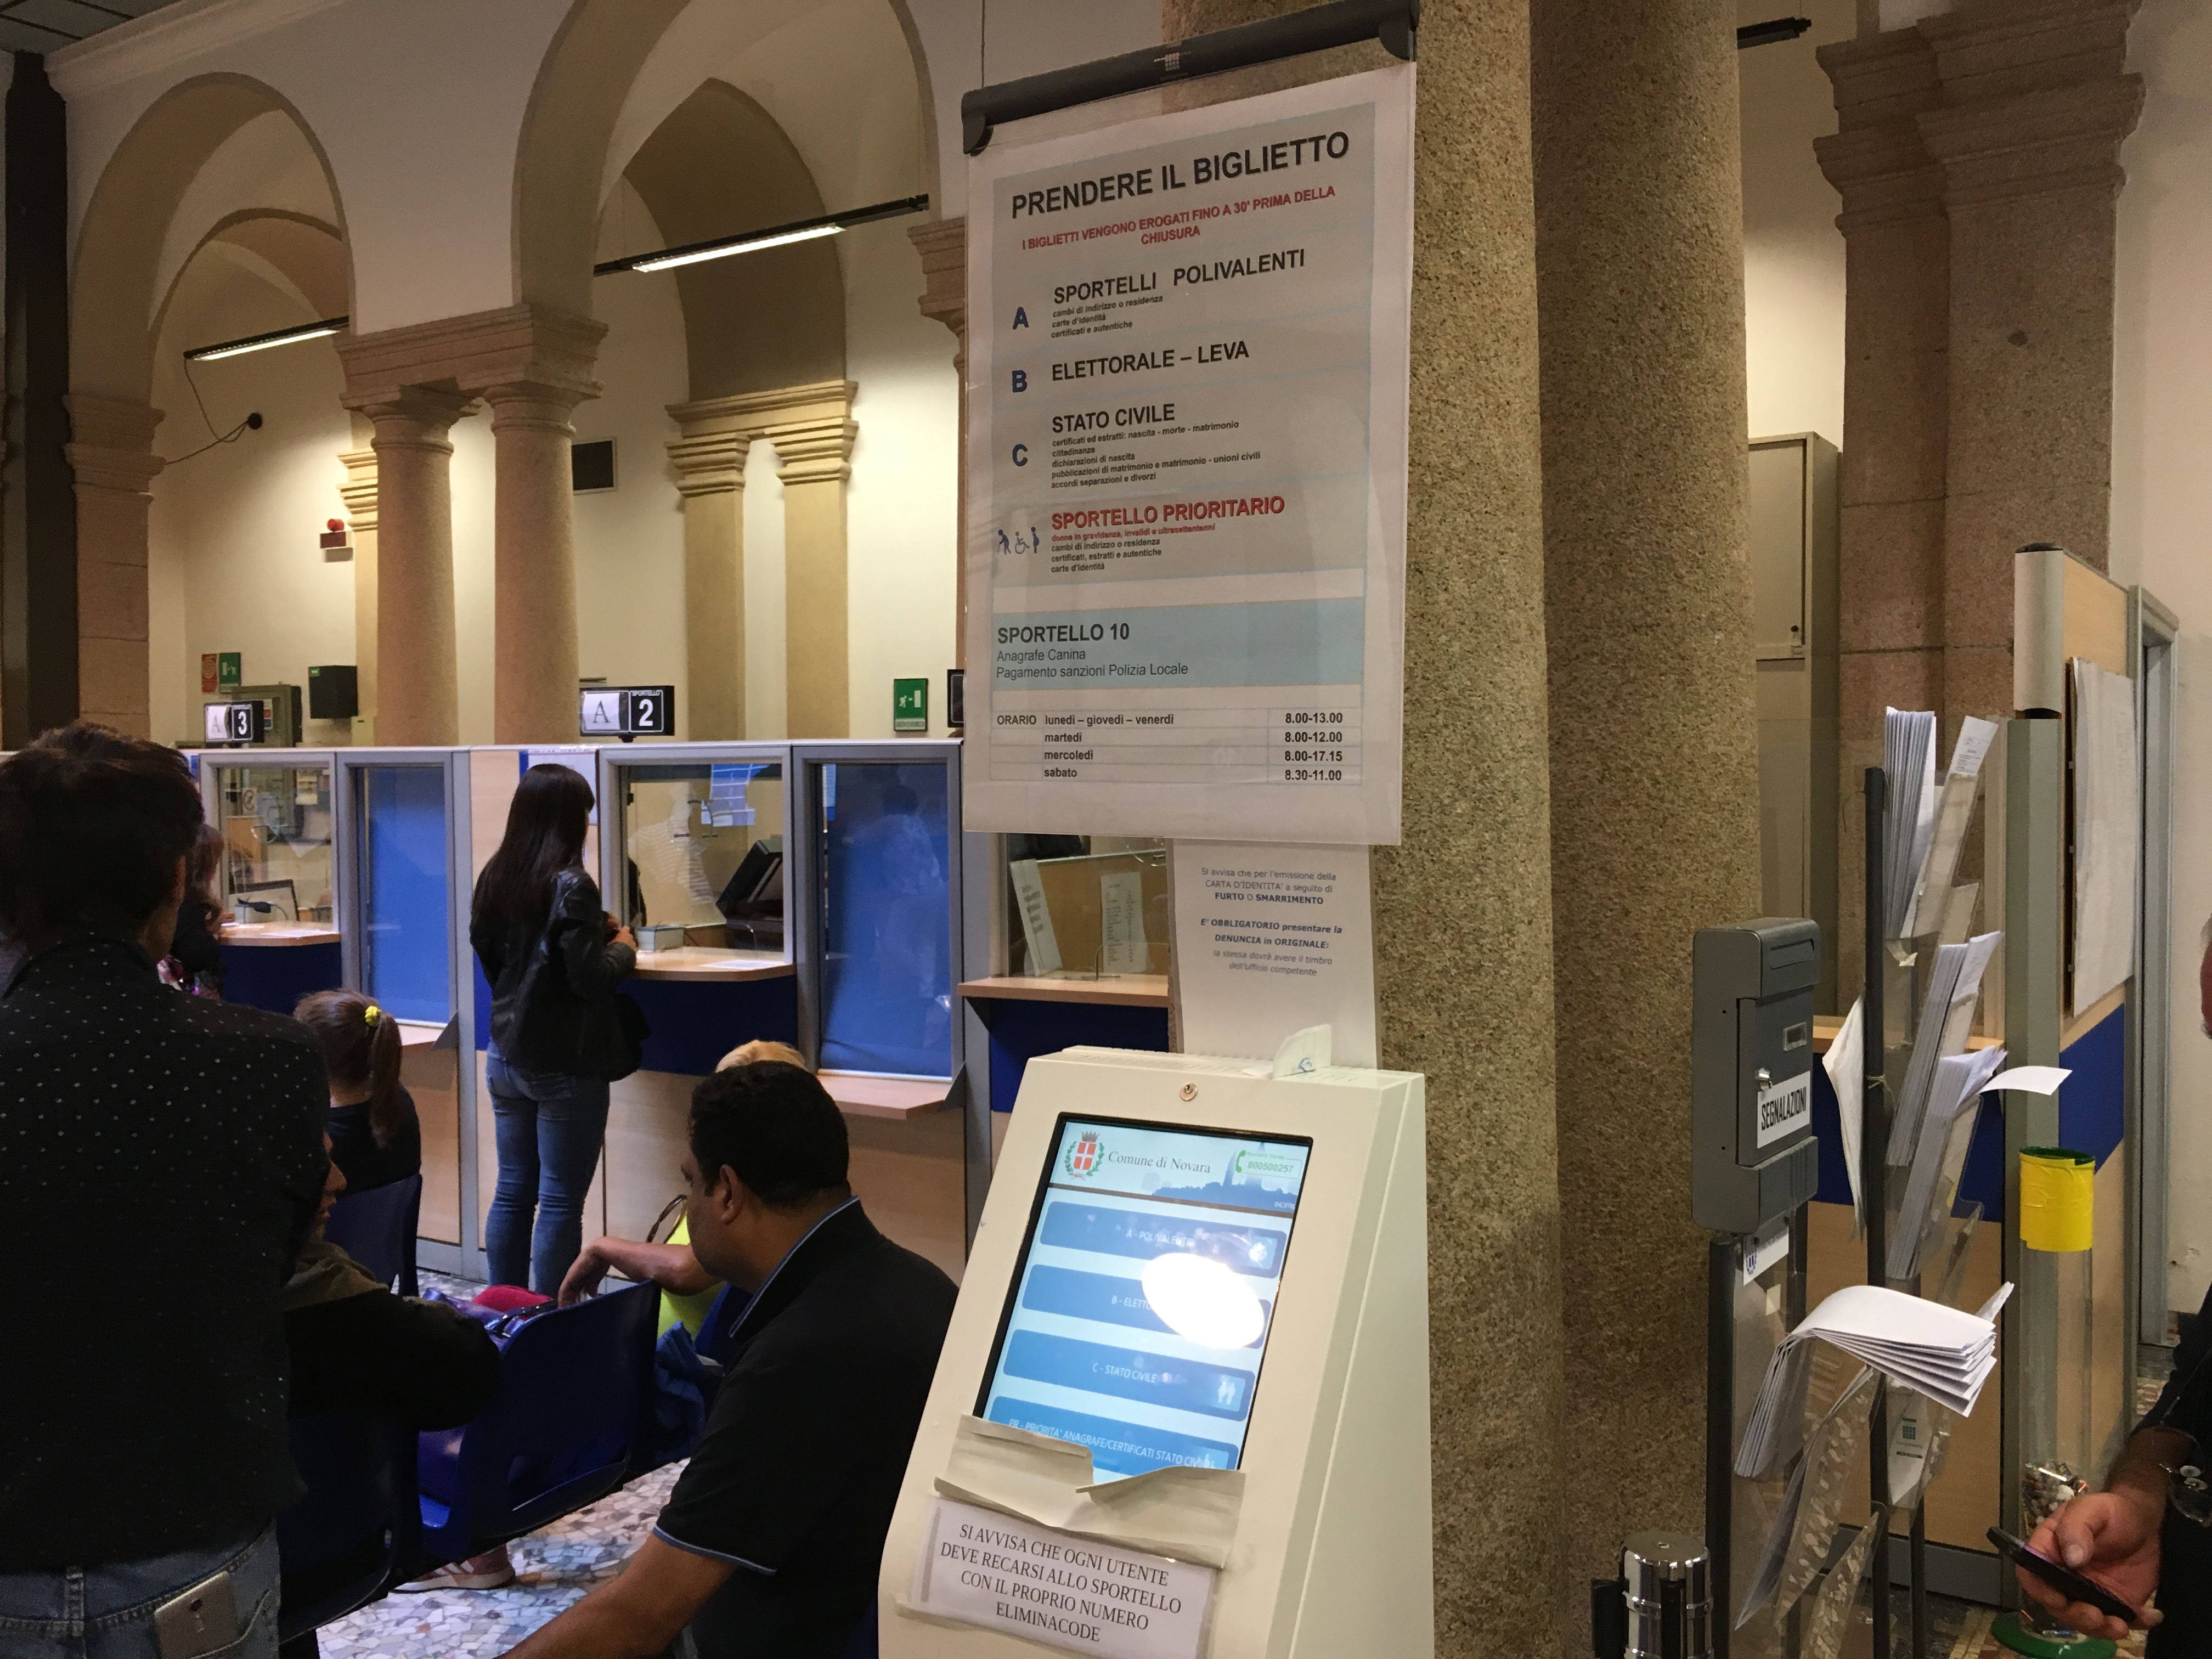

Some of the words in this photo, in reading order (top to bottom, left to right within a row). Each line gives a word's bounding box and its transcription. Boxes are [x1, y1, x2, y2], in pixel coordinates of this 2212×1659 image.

[1012, 169, 1153, 218] PRENDERE
[1162, 165, 1185, 190] IL
[1193, 131, 1349, 185] BIGLIETTO
[1028, 230, 1079, 249] BIGLIETTI
[1081, 222, 1136, 240] VENGONO
[1139, 212, 1189, 231] EROGATI
[1192, 207, 1220, 221] FINO
[1222, 205, 1232, 216] A
[1253, 193, 1291, 211] PRIMA
[1294, 186, 1335, 203] DELLA
[1141, 226, 1200, 246] CHIUSURA
[1054, 272, 1156, 304] SPORTELLI
[1173, 249, 1305, 286] POLIVALENTI
[1053, 308, 1074, 318] cambi
[1086, 302, 1116, 313] indirizzo
[1126, 296, 1163, 307] residenza
[1012, 307, 1029, 330] A
[1052, 318, 1070, 328] carte
[1051, 326, 1085, 338] certificati
[1093, 321, 1132, 332] autentiche
[1052, 349, 1175, 381] ELETTORALE
[1198, 341, 1249, 364] LEVA
[1012, 370, 1027, 391] B
[1052, 411, 1109, 433] STATO
[1115, 403, 1175, 427] CIVILE
[1052, 436, 1085, 447] certificati
[1128, 430, 1155, 438] nascita
[1163, 426, 1186, 435] morte
[1193, 421, 1239, 432] matrimonio
[1012, 444, 1028, 467] C
[1052, 446, 1095, 456] cittadinanze
[1052, 457, 1097, 467] dichiarazioni
[1109, 453, 1135, 461] nascita
[1052, 467, 1099, 479] pubblicazioni
[1110, 462, 1153, 472] matrimonio
[1162, 456, 1206, 468] matrimonio
[1214, 454, 1239, 463] unioni
[1242, 452, 1261, 460] civili
[1051, 478, 1078, 488] accordi
[1080, 475, 1122, 487] separazioni
[1131, 472, 1156, 481] divorzi
[1052, 506, 1158, 530] SPORTELLO
[1163, 496, 1284, 521] PRIORITARIO
[1052, 533, 1073, 542] donne
[1083, 529, 1123, 541] gravidanza,
[1125, 528, 1150, 537] invalidi
[1052, 542, 1073, 551] cambi
[1084, 539, 1115, 549] indirizzo
[1124, 538, 1160, 548] residenza
[1052, 552, 1087, 562] certificati,
[1089, 551, 1114, 560] estratti
[1123, 548, 1161, 557] autentiche
[997, 624, 1104, 644] SPORTELLO
[1110, 623, 1130, 641] 10
[997, 649, 1045, 664] Anagrafe
[1048, 648, 1086, 661] Canina
[996, 665, 1057, 680] Pagamento
[1060, 663, 1105, 678] sanzioni
[1109, 663, 1147, 676] Polizia
[1150, 662, 1188, 676] Locale
[592, 700, 610, 723] A
[639, 699, 653, 726] 2
[997, 715, 1036, 725] ORARIO
[1285, 712, 1343, 724] 8.00-13.00
[238, 712, 247, 735] 3
[1285, 731, 1342, 743] 8.00-12.00
[1284, 749, 1342, 762] 8.00-17.15
[1044, 768, 1077, 777] sabato
[1284, 769, 1342, 781] 8.30-11.00
[1269, 870, 1314, 880] l'emissione
[1317, 872, 1336, 881] della
[1205, 880, 1231, 888] CARTA
[1294, 884, 1323, 893] seguito
[1256, 894, 1323, 905] SMARRIMENTO
[1211, 919, 1279, 930] OBBLIGATORIO
[1282, 923, 1331, 933] presentare
[1215, 935, 1261, 944] DENUNCIA
[1274, 938, 1329, 949] ORIGINALE:
[1223, 950, 1246, 959] stessa
[1250, 952, 1272, 960] dovrà
[1274, 954, 1296, 962] avere
[1306, 956, 1332, 964] timbro
[1271, 966, 1317, 975] competente
[1761, 1086, 1806, 1131] SEGNALAZIONI
[1108, 1151, 1153, 1168] Comune
[1156, 1156, 1166, 1168] di
[1170, 1158, 1211, 1173] Novara
[1248, 1161, 1294, 1172] 800500257
[1111, 1295, 1117, 1304] B
[1093, 1363, 1098, 1373] C
[1105, 1365, 1130, 1378] STATO
[1132, 1369, 1156, 1383] CIVILE
[1063, 1431, 1154, 1458] ANAGRAFE/CERTIFICATI
[1156, 1451, 1183, 1464] STATO
[960, 1523, 973, 1538] SI
[976, 1528, 1027, 1552] AVVISA
[1031, 1541, 1061, 1560] CHE
[1064, 1549, 1103, 1570] OGNI
[1107, 1558, 1169, 1586] UTENTE
[941, 1542, 979, 1563] DEVE
[981, 1552, 1044, 1580] RECARSI
[1046, 1568, 1087, 1590] ALLO
[1091, 1578, 1181, 1614] SPORTELLO
[961, 1570, 992, 1590] CON
[995, 1579, 1009, 1595] IL
[1012, 1582, 1076, 1612] PROPRIO
[1080, 1599, 1148, 1630] NUMERO
[996, 1601, 1100, 1642] ELIMINACODE
